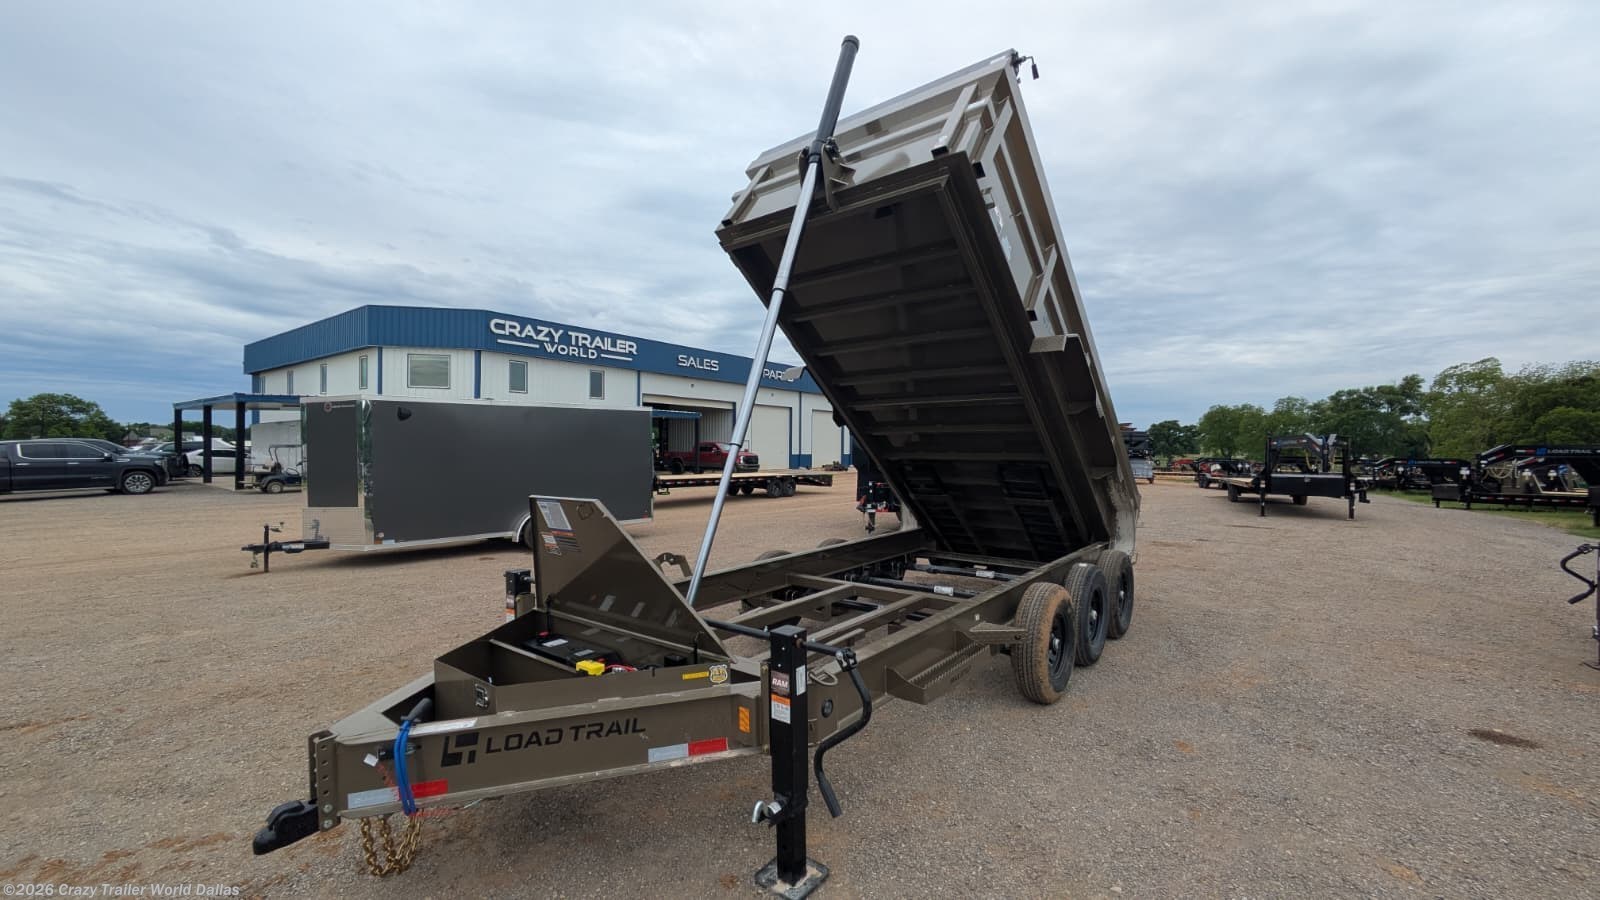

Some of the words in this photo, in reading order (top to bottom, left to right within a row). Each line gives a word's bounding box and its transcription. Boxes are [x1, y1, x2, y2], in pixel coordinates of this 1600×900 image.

[489, 318, 564, 343] CRAZY
[568, 331, 638, 355] TRAILER
[543, 342, 598, 359] WORLD
[678, 354, 719, 371] SALES
[763, 368, 794, 382] PAR
[772, 678, 789, 688] RAM
[485, 728, 563, 754] LOAD
[569, 717, 646, 741] TRAIL
